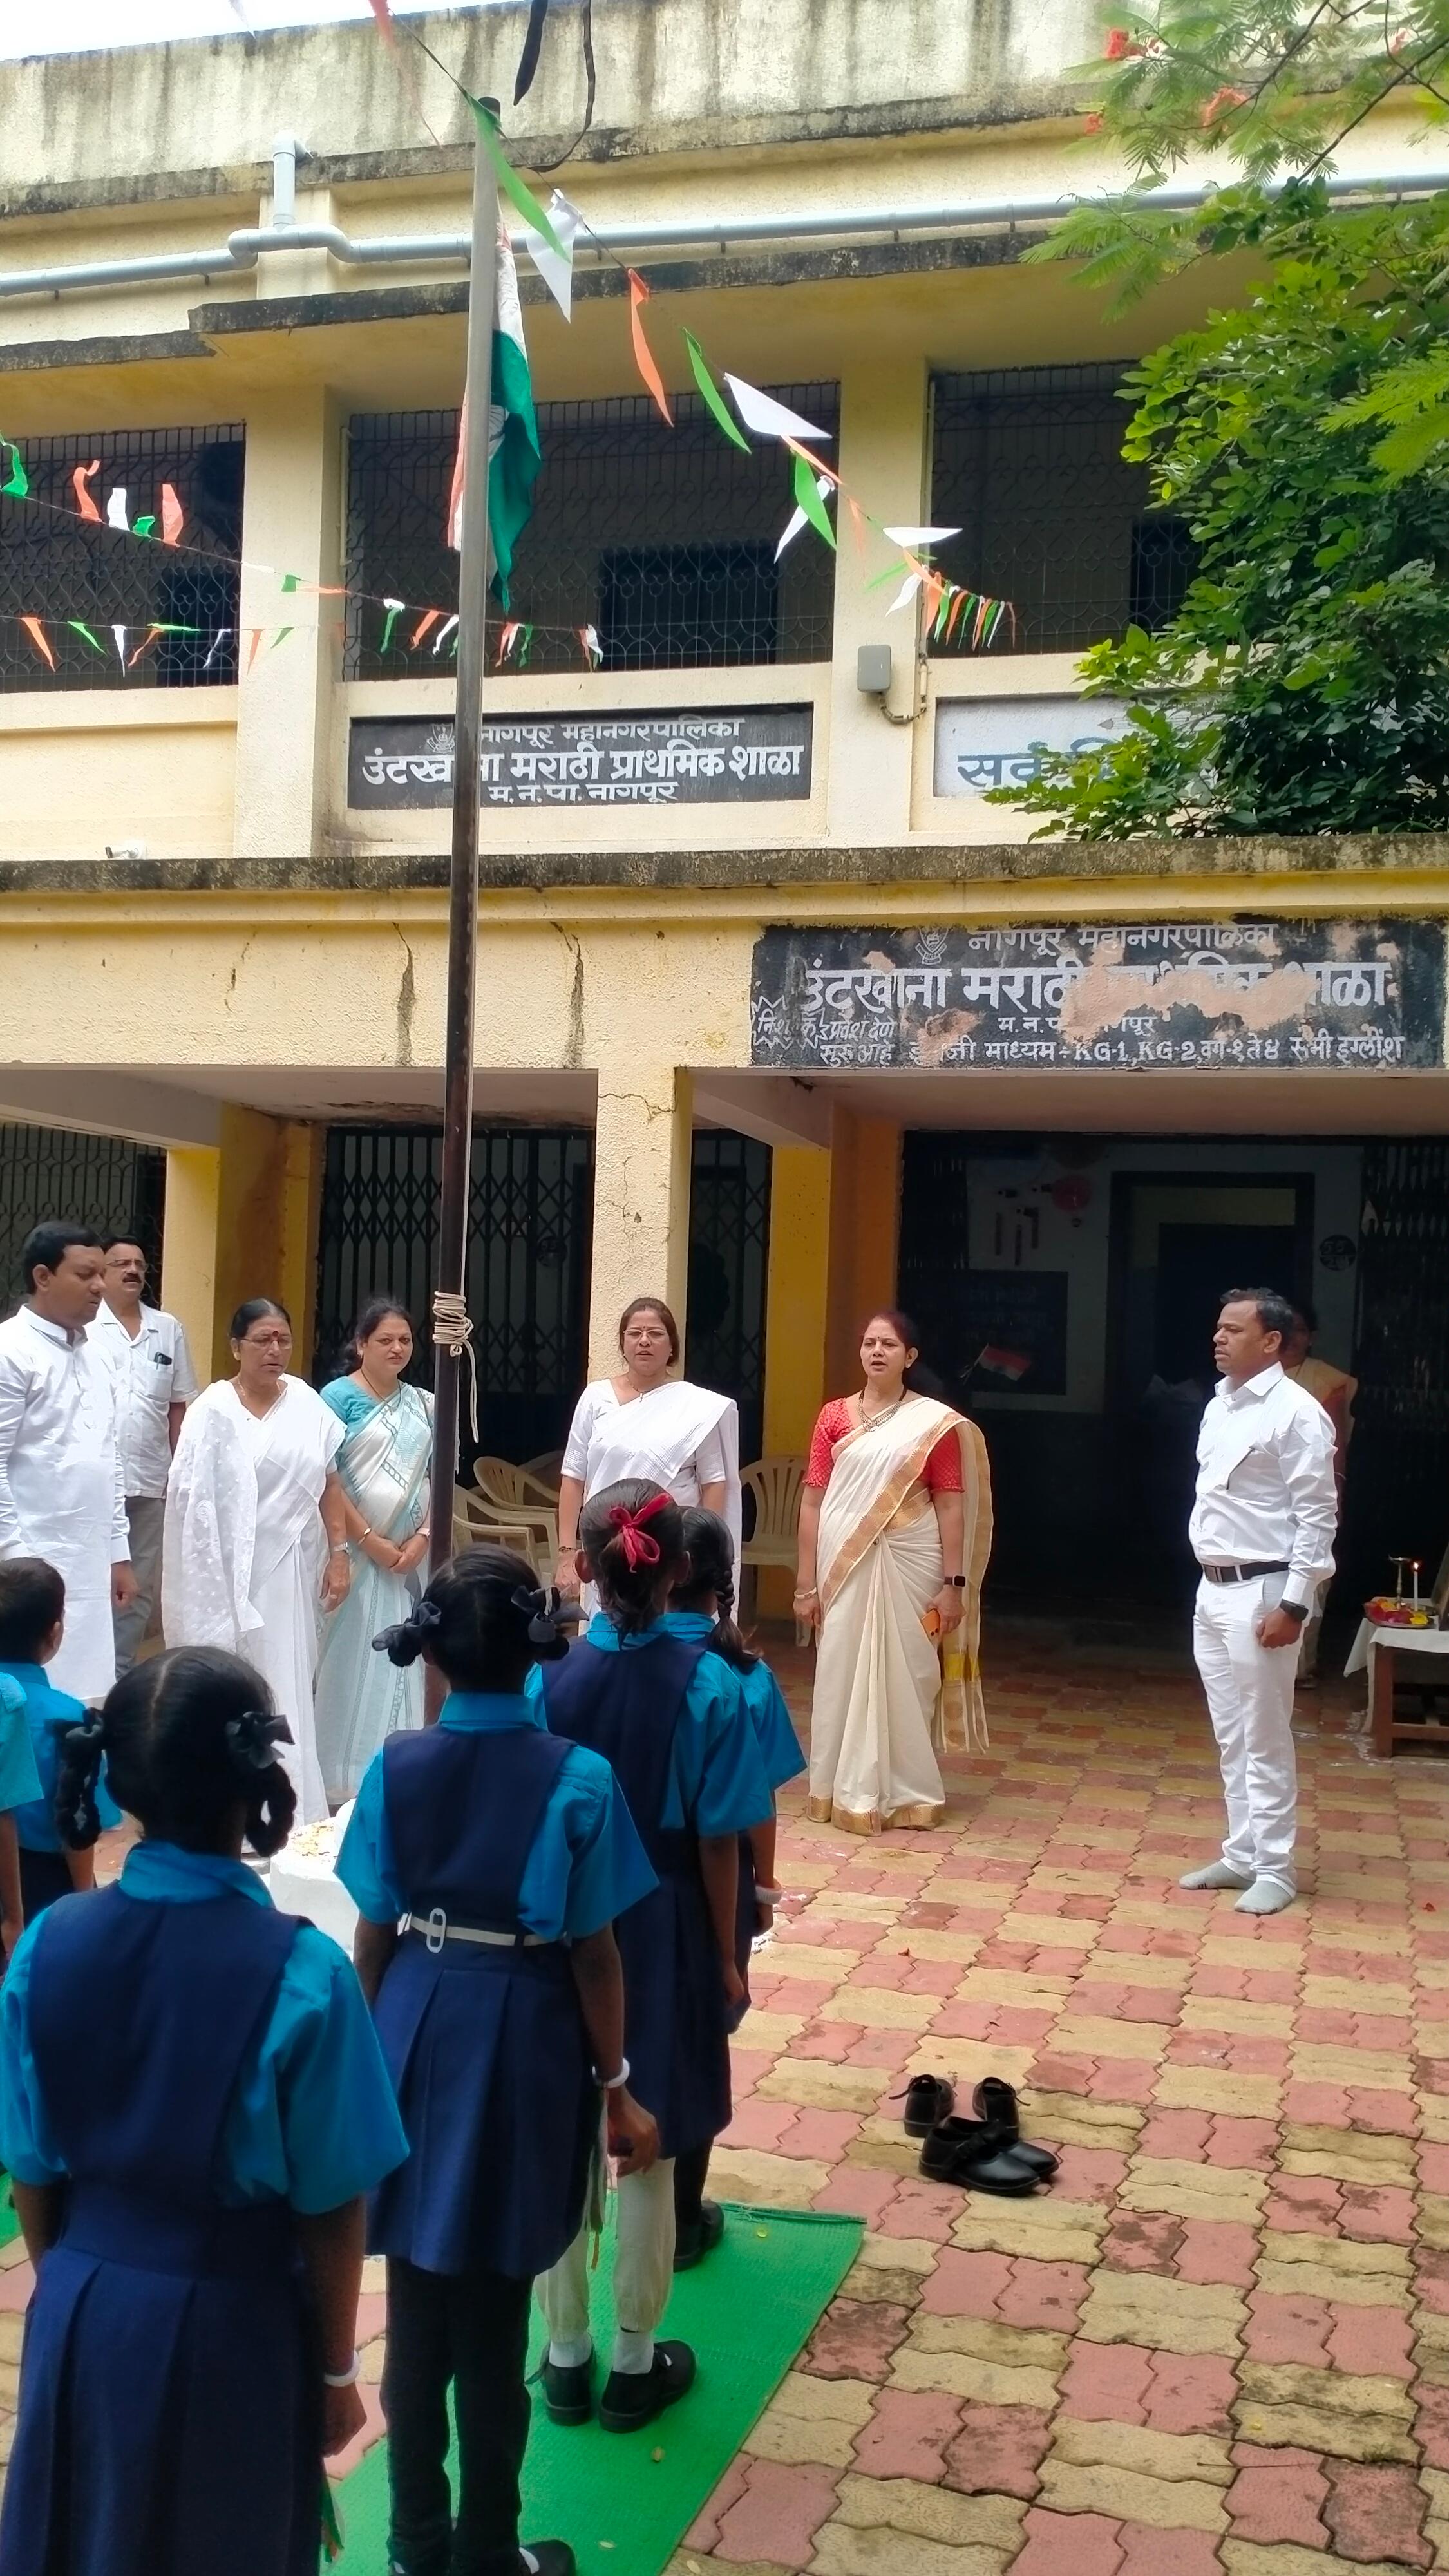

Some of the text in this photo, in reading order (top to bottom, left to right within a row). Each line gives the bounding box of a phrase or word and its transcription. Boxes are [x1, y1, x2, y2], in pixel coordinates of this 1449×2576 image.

[362, 739, 805, 785] उंटखा मराठी प्राथमिक शाळा
[585, 781, 680, 803] नागपूर
[967, 927, 1066, 957] नागपूर
[983, 1041, 1057, 1062] माध्यम
